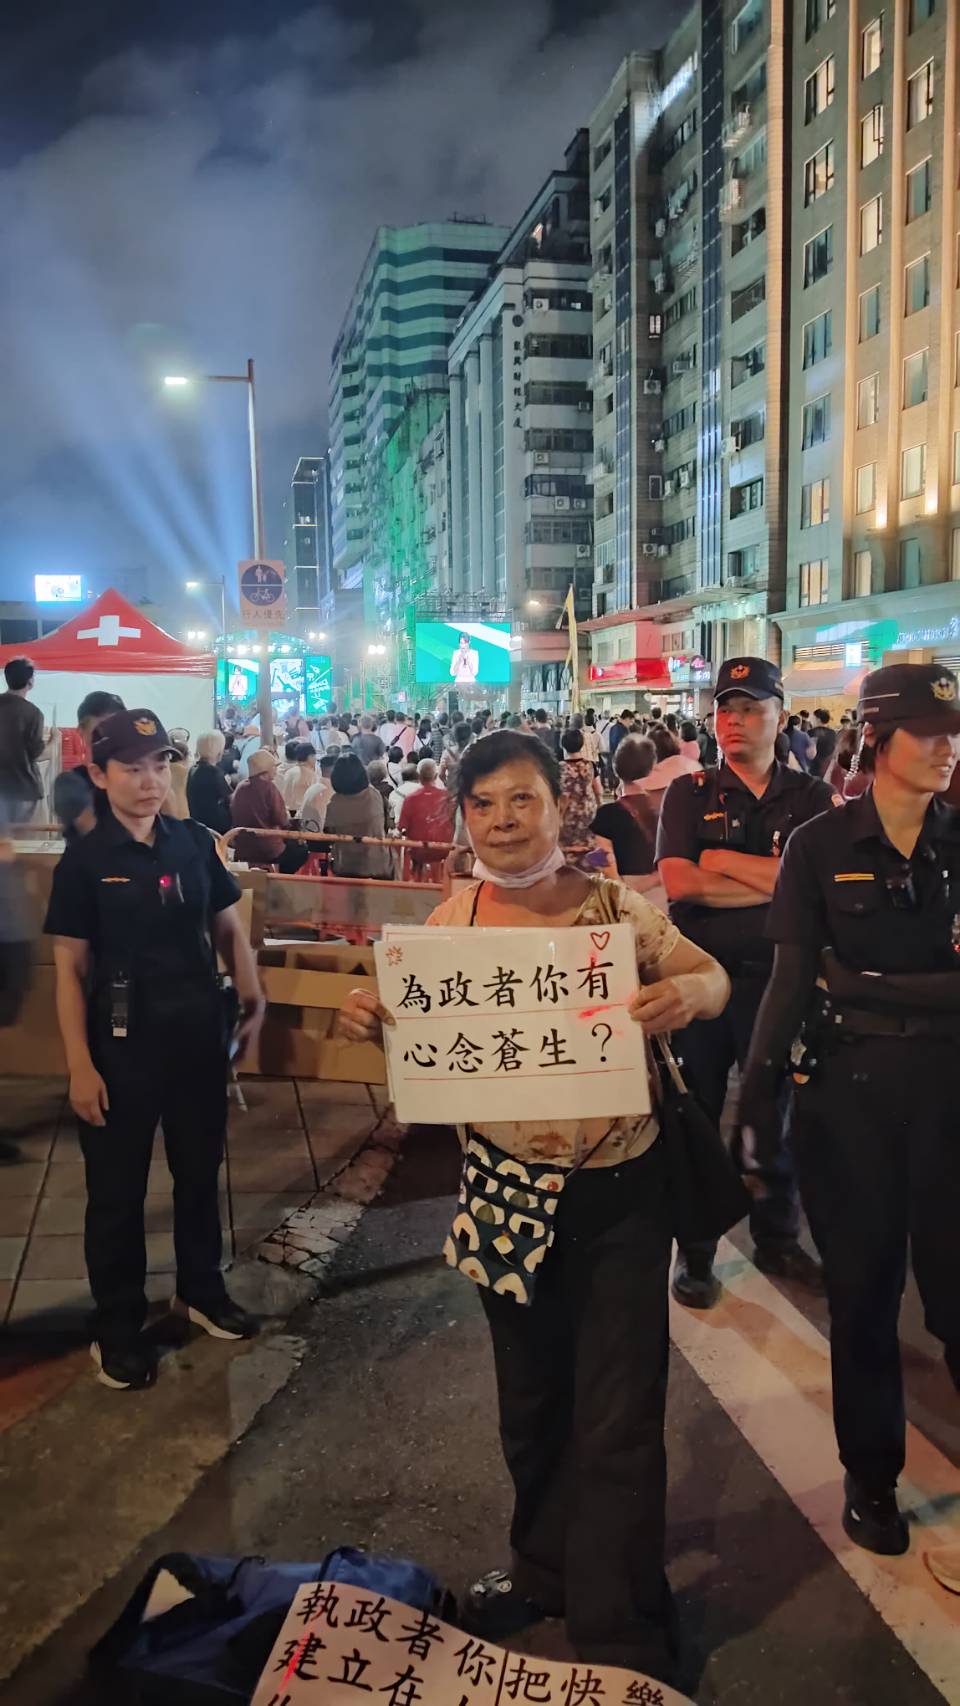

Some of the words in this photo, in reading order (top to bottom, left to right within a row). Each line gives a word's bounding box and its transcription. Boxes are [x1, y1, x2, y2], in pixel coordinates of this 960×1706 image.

[396, 957, 614, 1013] 為政者你有
[403, 1022, 612, 1073] 心念蒼生？
